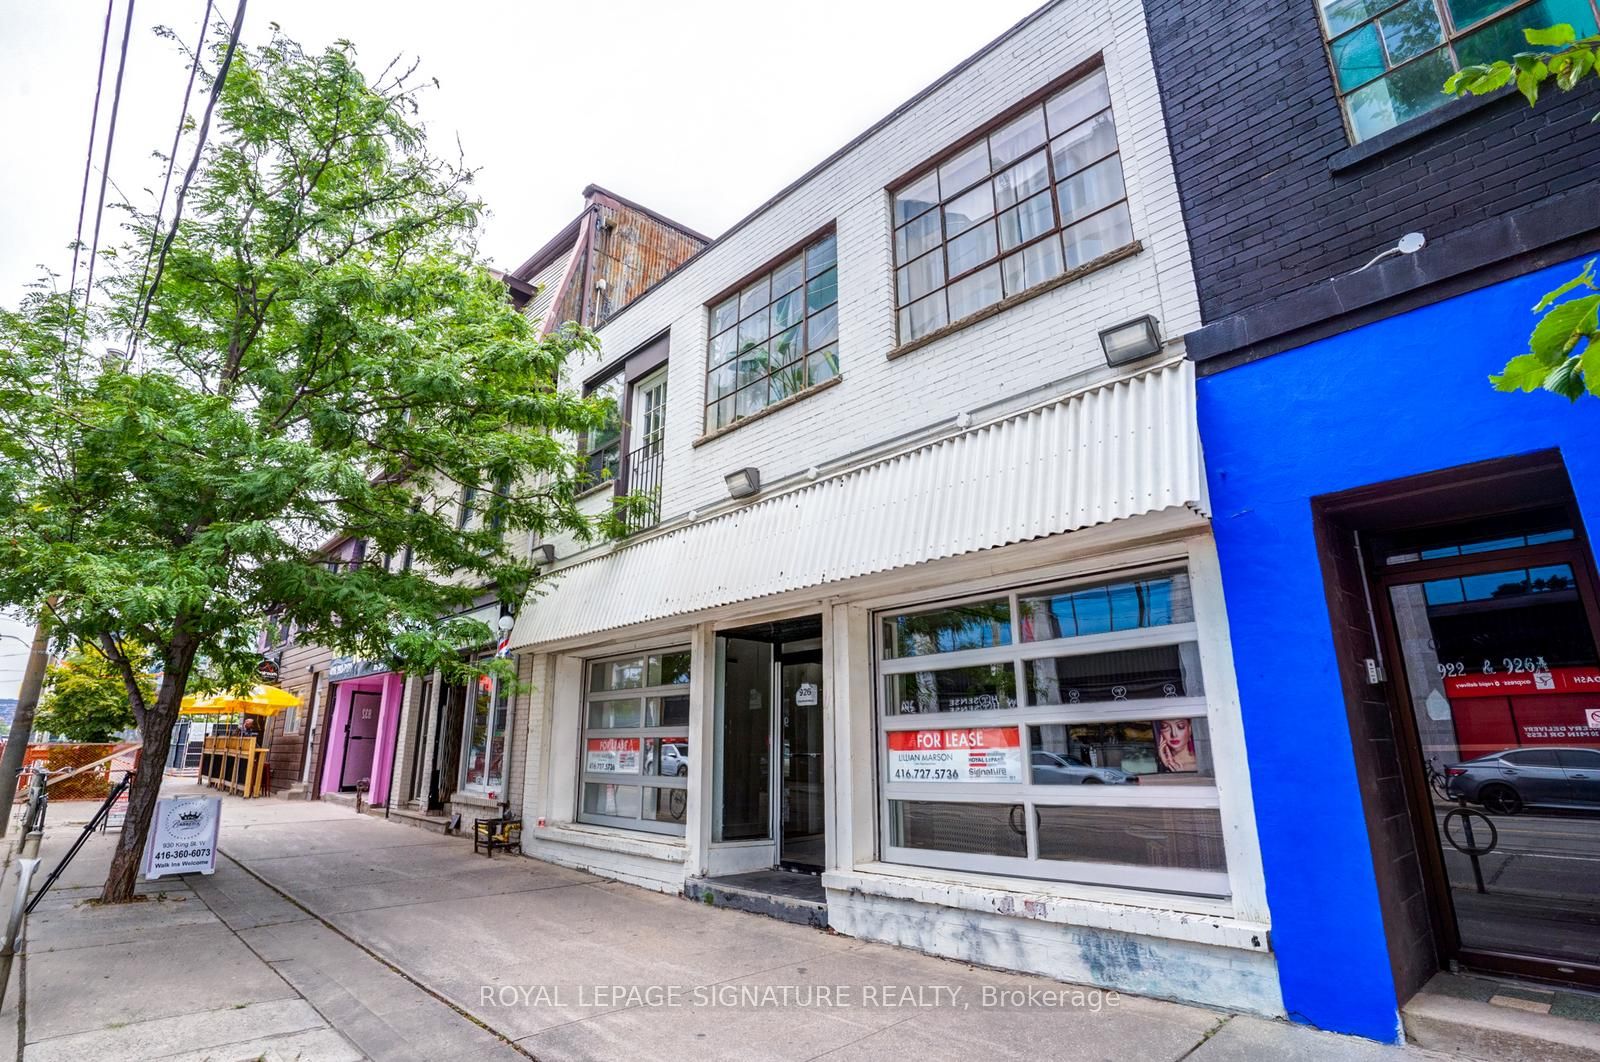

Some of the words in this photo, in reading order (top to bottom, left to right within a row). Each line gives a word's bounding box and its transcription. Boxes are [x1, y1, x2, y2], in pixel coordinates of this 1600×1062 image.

[1437, 662, 1466, 679] 922
[1482, 660, 1496, 675] &
[799, 688, 812, 697] 926
[917, 733, 942, 748] FOR
[945, 730, 984, 747] LEASE
[895, 768, 959, 780] 416.727.5736
[968, 767, 1007, 777] Signature
[155, 848, 211, 860] 416-360-6073
